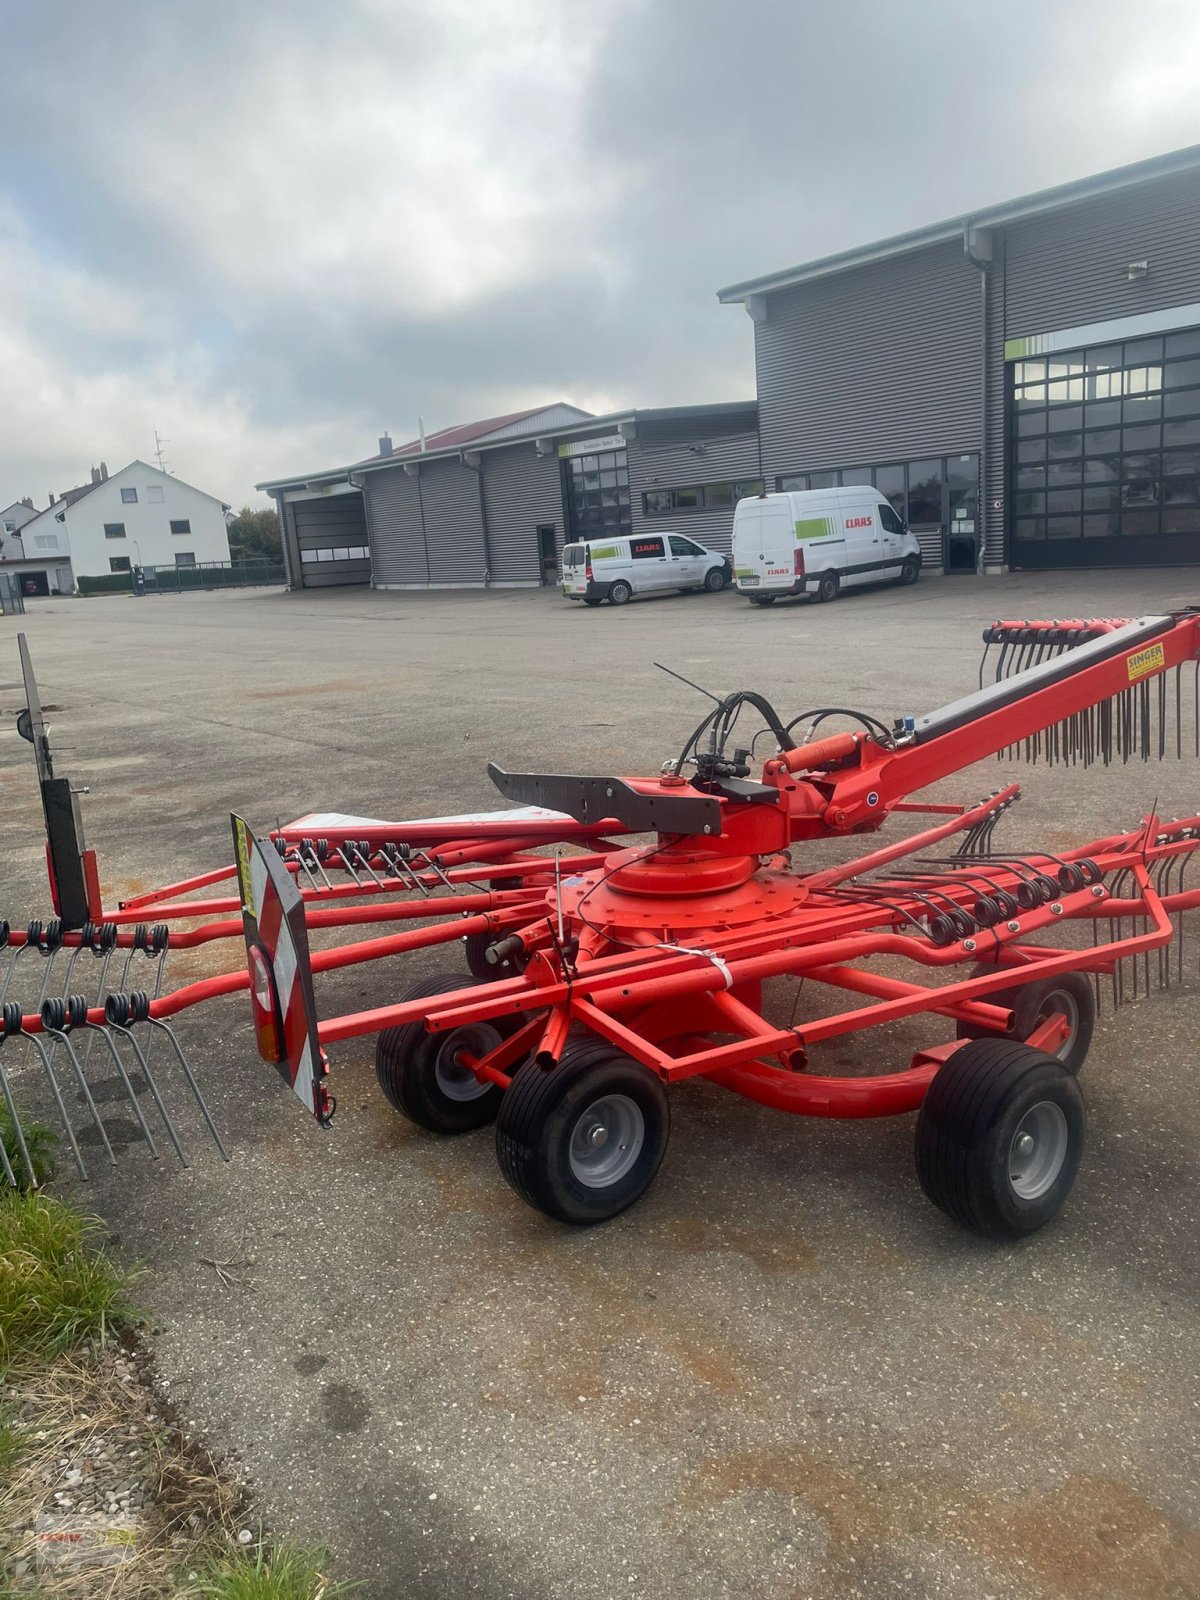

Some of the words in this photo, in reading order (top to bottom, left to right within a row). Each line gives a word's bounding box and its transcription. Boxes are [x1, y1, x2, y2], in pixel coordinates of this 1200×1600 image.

[845, 517, 872, 529] CLAAS
[635, 543, 661, 553] CLAAS
[1128, 645, 1162, 668] SINGER
